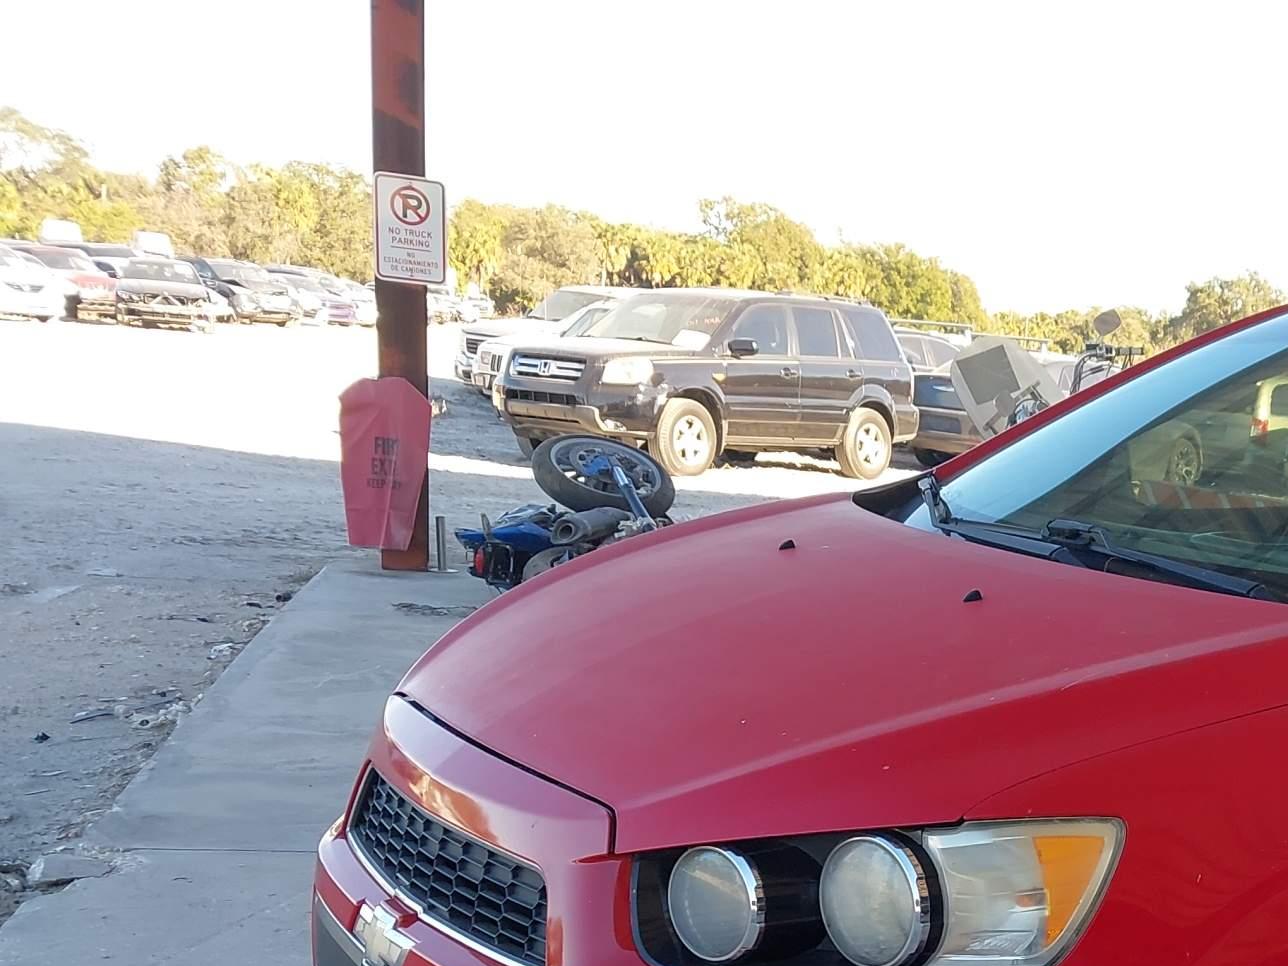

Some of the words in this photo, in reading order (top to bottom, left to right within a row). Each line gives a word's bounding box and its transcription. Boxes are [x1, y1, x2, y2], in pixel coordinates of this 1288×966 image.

[388, 226, 401, 235] NO
[404, 228, 433, 239] TRUCK
[391, 235, 430, 248] PARKING
